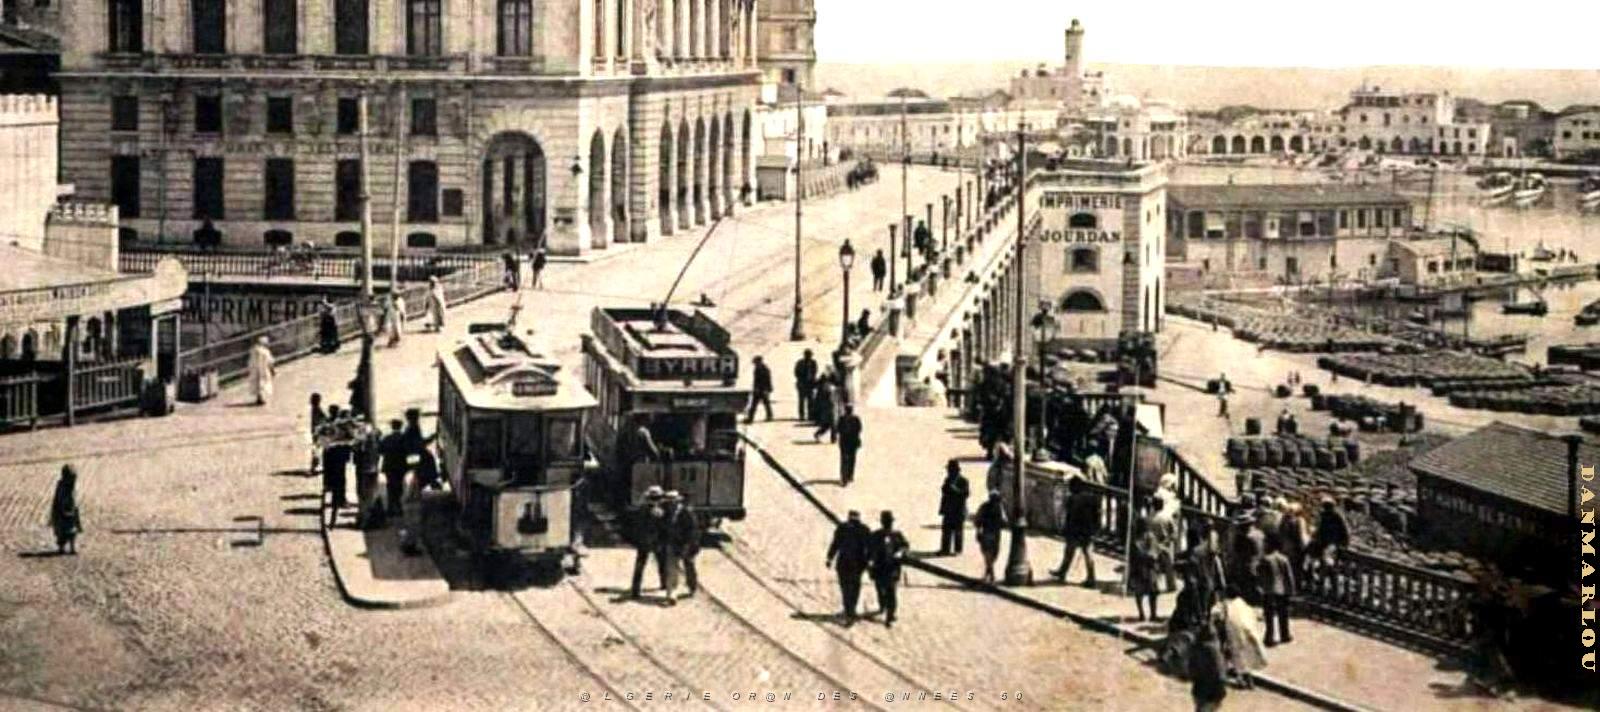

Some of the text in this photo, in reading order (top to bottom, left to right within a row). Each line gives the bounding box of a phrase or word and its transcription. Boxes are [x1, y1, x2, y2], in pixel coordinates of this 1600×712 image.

[1038, 194, 1122, 209] IMPRIMERIE
[1039, 229, 1121, 243] JOURDAN
[644, 354, 736, 373] BYRRH
